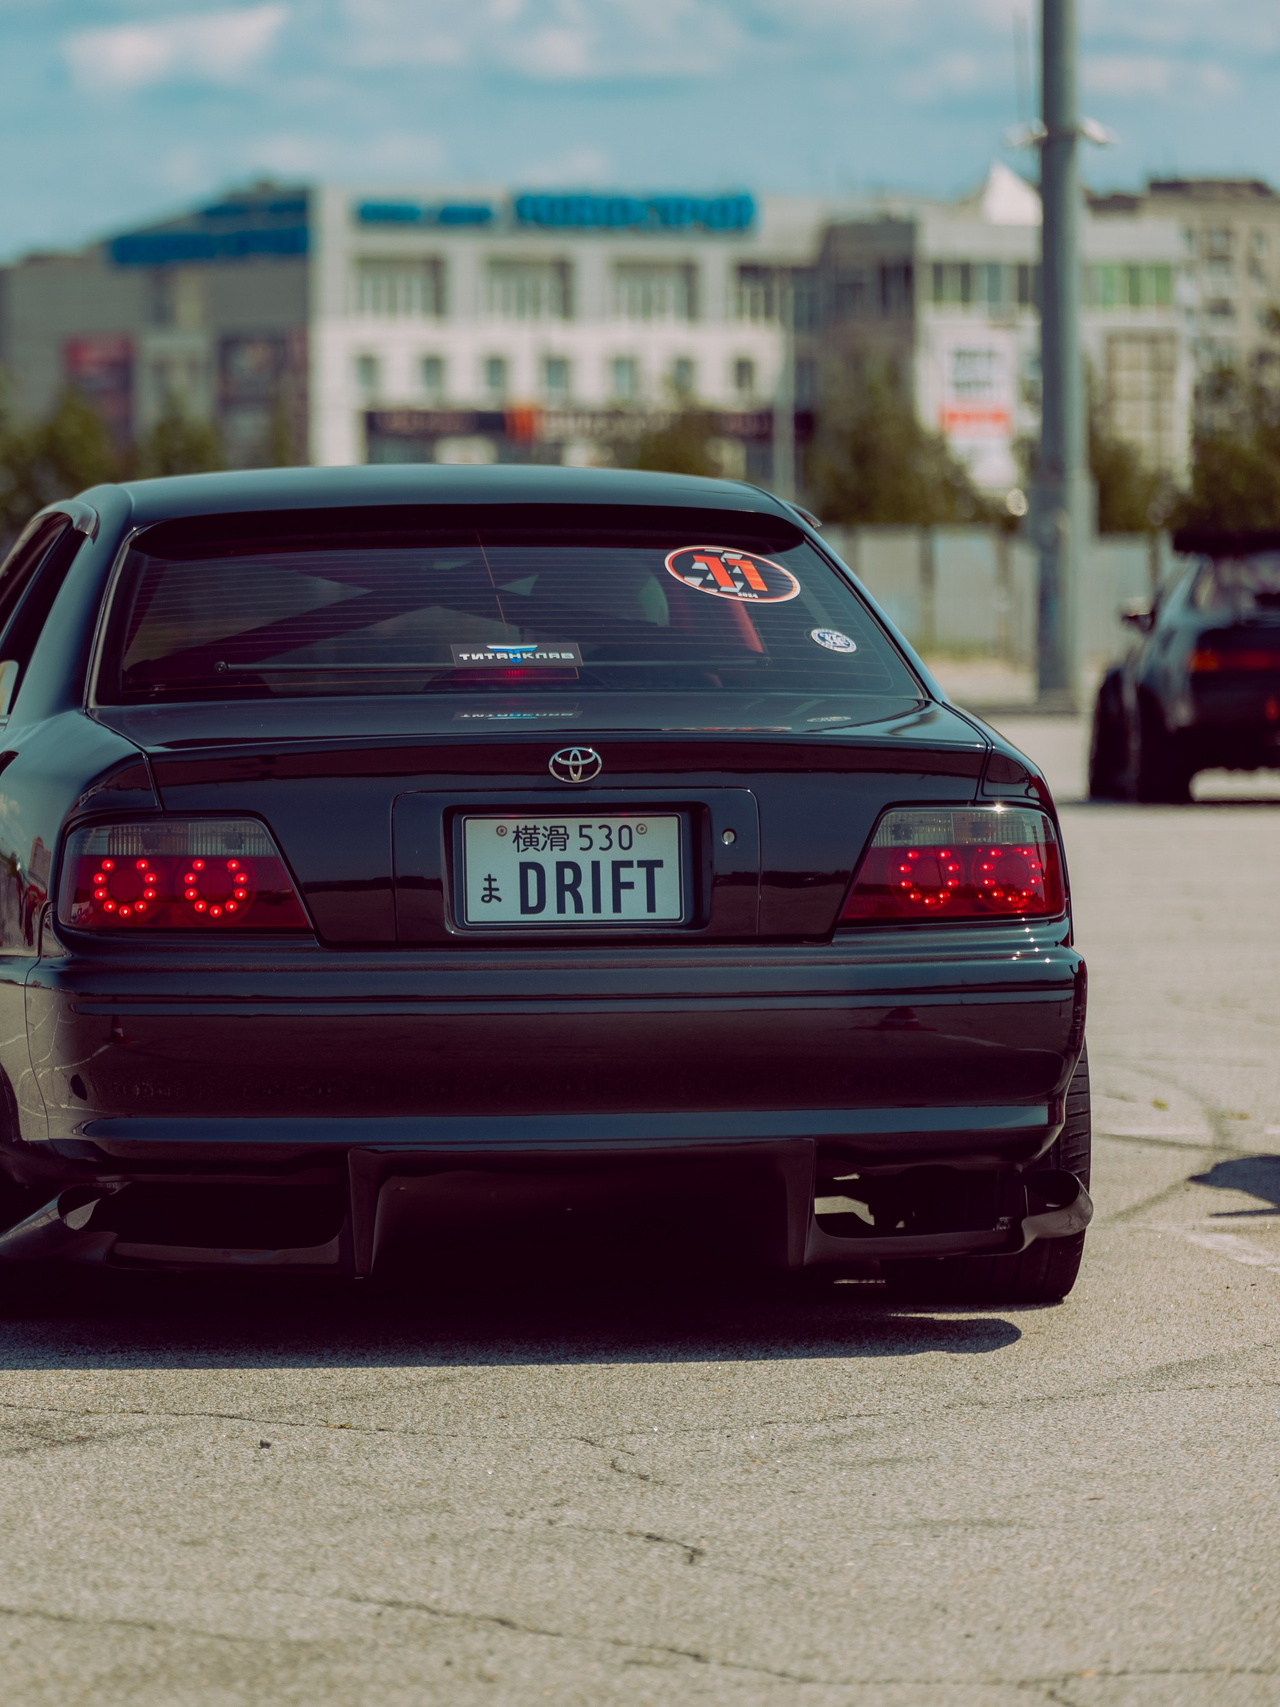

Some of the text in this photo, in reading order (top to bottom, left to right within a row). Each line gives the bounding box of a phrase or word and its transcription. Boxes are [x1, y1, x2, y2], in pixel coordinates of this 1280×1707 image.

[513, 824, 633, 853] 横滑 530
[481, 860, 664, 915] ま DRIFT
